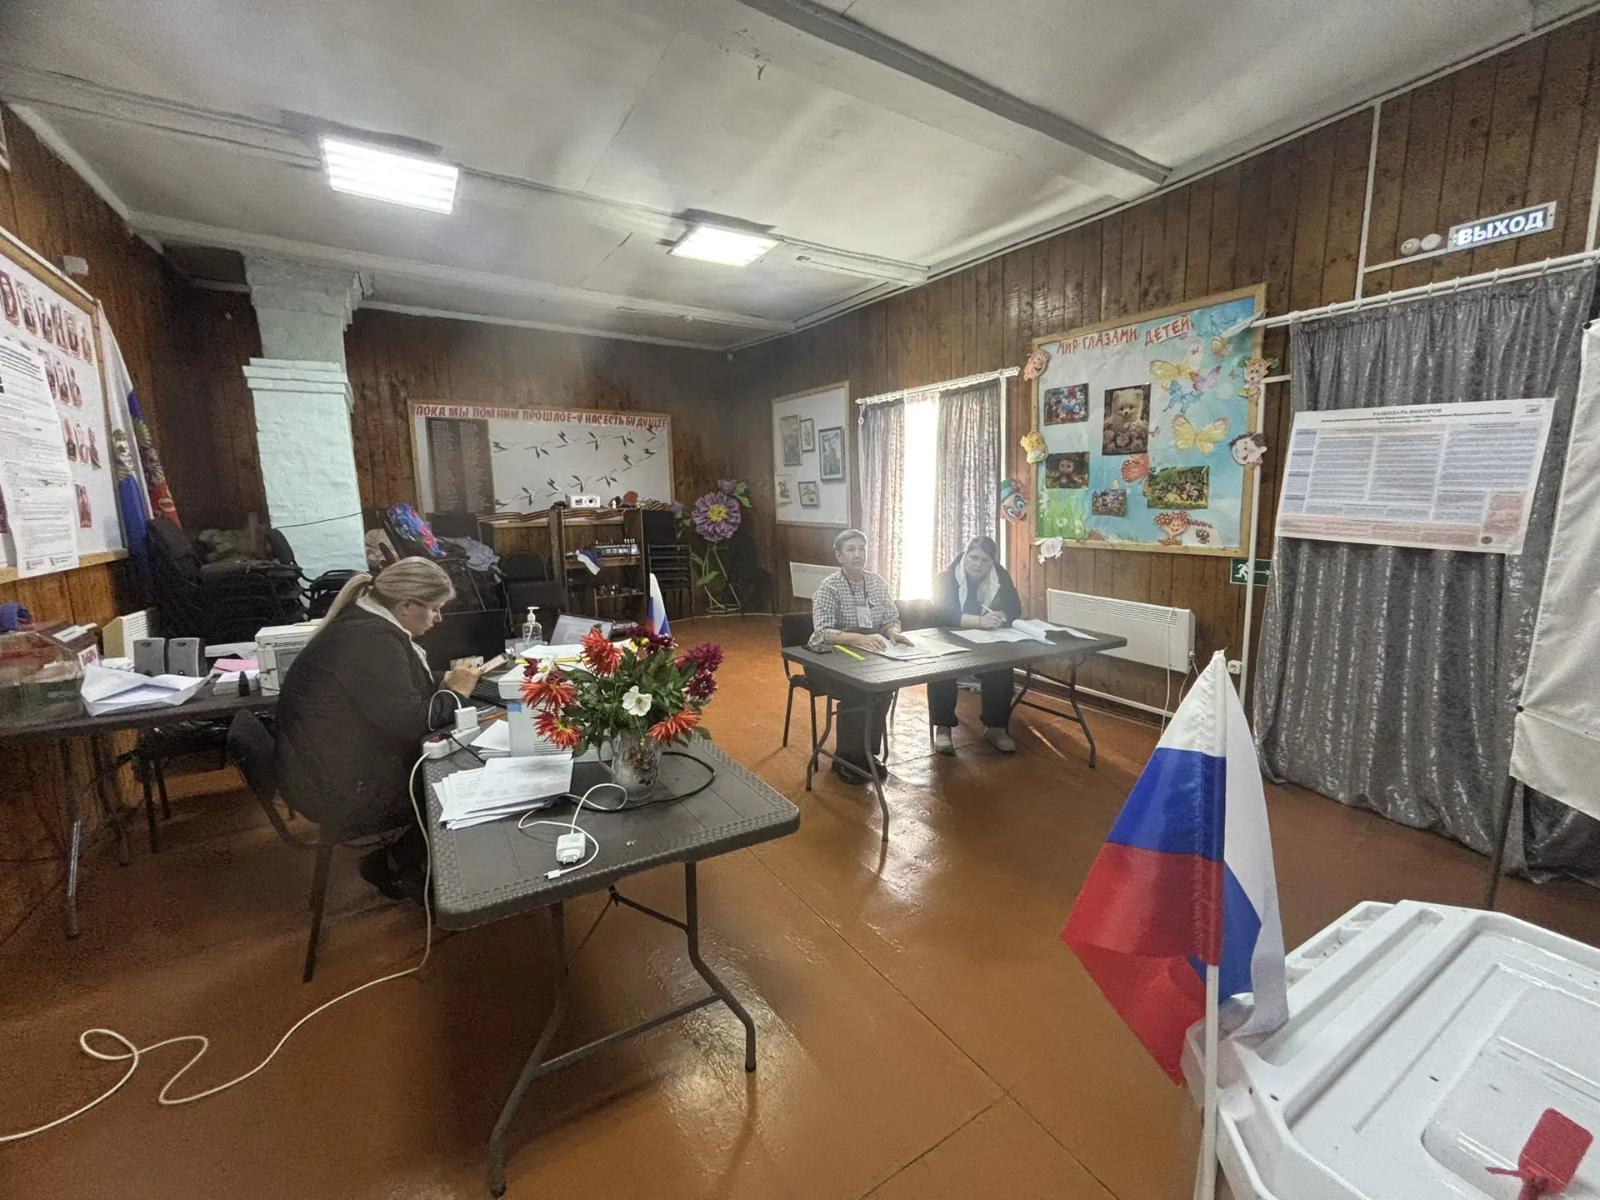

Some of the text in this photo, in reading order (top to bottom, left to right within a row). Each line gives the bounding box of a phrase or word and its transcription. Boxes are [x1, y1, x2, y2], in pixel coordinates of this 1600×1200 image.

[1457, 211, 1544, 246] ВЫХОД
[1056, 314, 1191, 355] МИР ГЛАЗАМИ ДЕТЕЙ
[416, 405, 446, 417] ПОКА
[448, 407, 469, 418] МЫ
[473, 407, 519, 420] ПОМНИМ
[585, 413, 602, 425] НАС
[603, 415, 625, 426] ЕСТЬ
[625, 416, 667, 429] БУДУЩЕЕ
